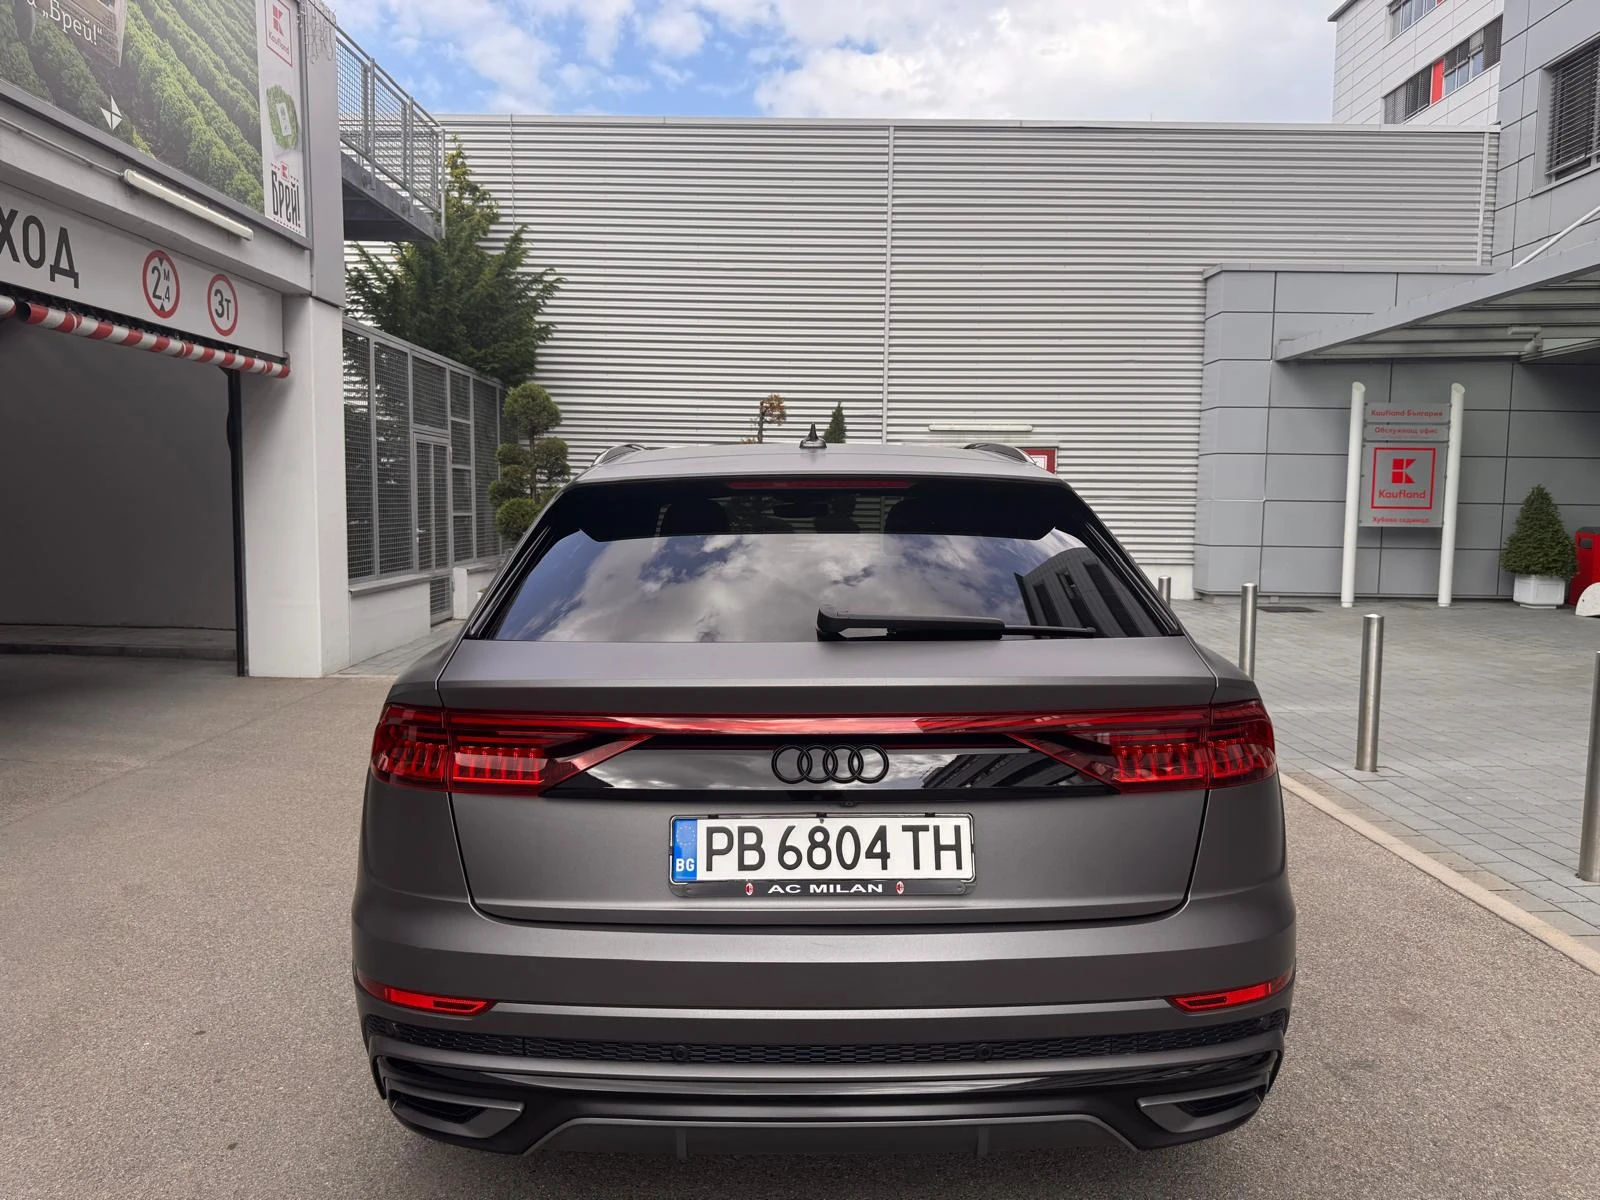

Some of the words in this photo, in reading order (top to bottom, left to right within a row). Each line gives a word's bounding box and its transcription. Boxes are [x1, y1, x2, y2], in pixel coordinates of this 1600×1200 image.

[1371, 409, 1405, 417] Kaufland
[1407, 408, 1443, 418] България
[1378, 489, 1427, 499] Kaufland
[705, 825, 766, 872] PB
[777, 825, 891, 871] 6804
[901, 824, 963, 871] TH
[675, 858, 695, 872] BG
[767, 884, 801, 894] AC
[809, 883, 883, 893] MILAN
